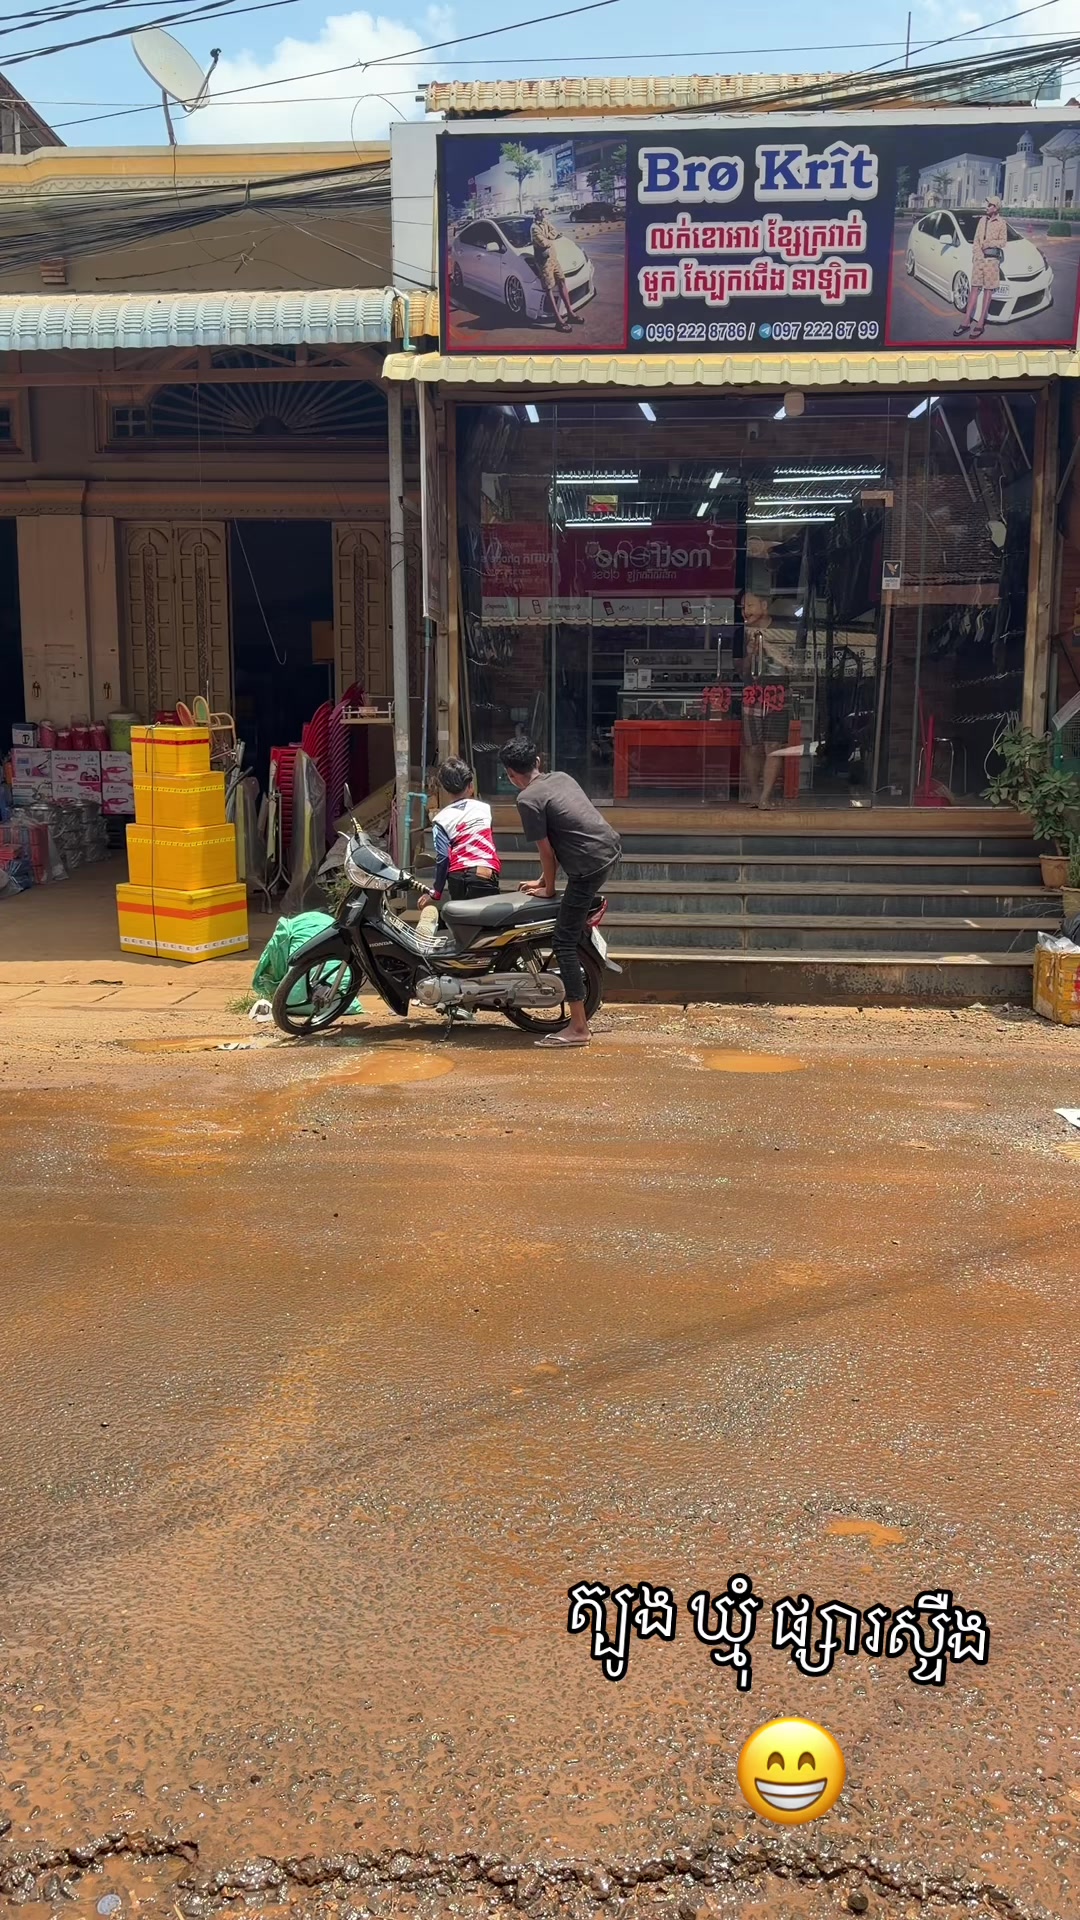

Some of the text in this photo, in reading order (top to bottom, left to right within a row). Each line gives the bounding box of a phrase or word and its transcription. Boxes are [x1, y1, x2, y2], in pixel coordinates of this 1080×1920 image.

[650, 217, 760, 249] លក់ខោអាវ
[643, 261, 868, 301] មួក ស្បែកជើង នាឡិកា
[647, 323, 674, 341] 096
[677, 323, 706, 341] 222
[772, 322, 801, 340] 097
[803, 321, 833, 340] 222
[836, 321, 856, 340] 87
[858, 320, 879, 340] 99
[369, 940, 394, 948] HONDA
